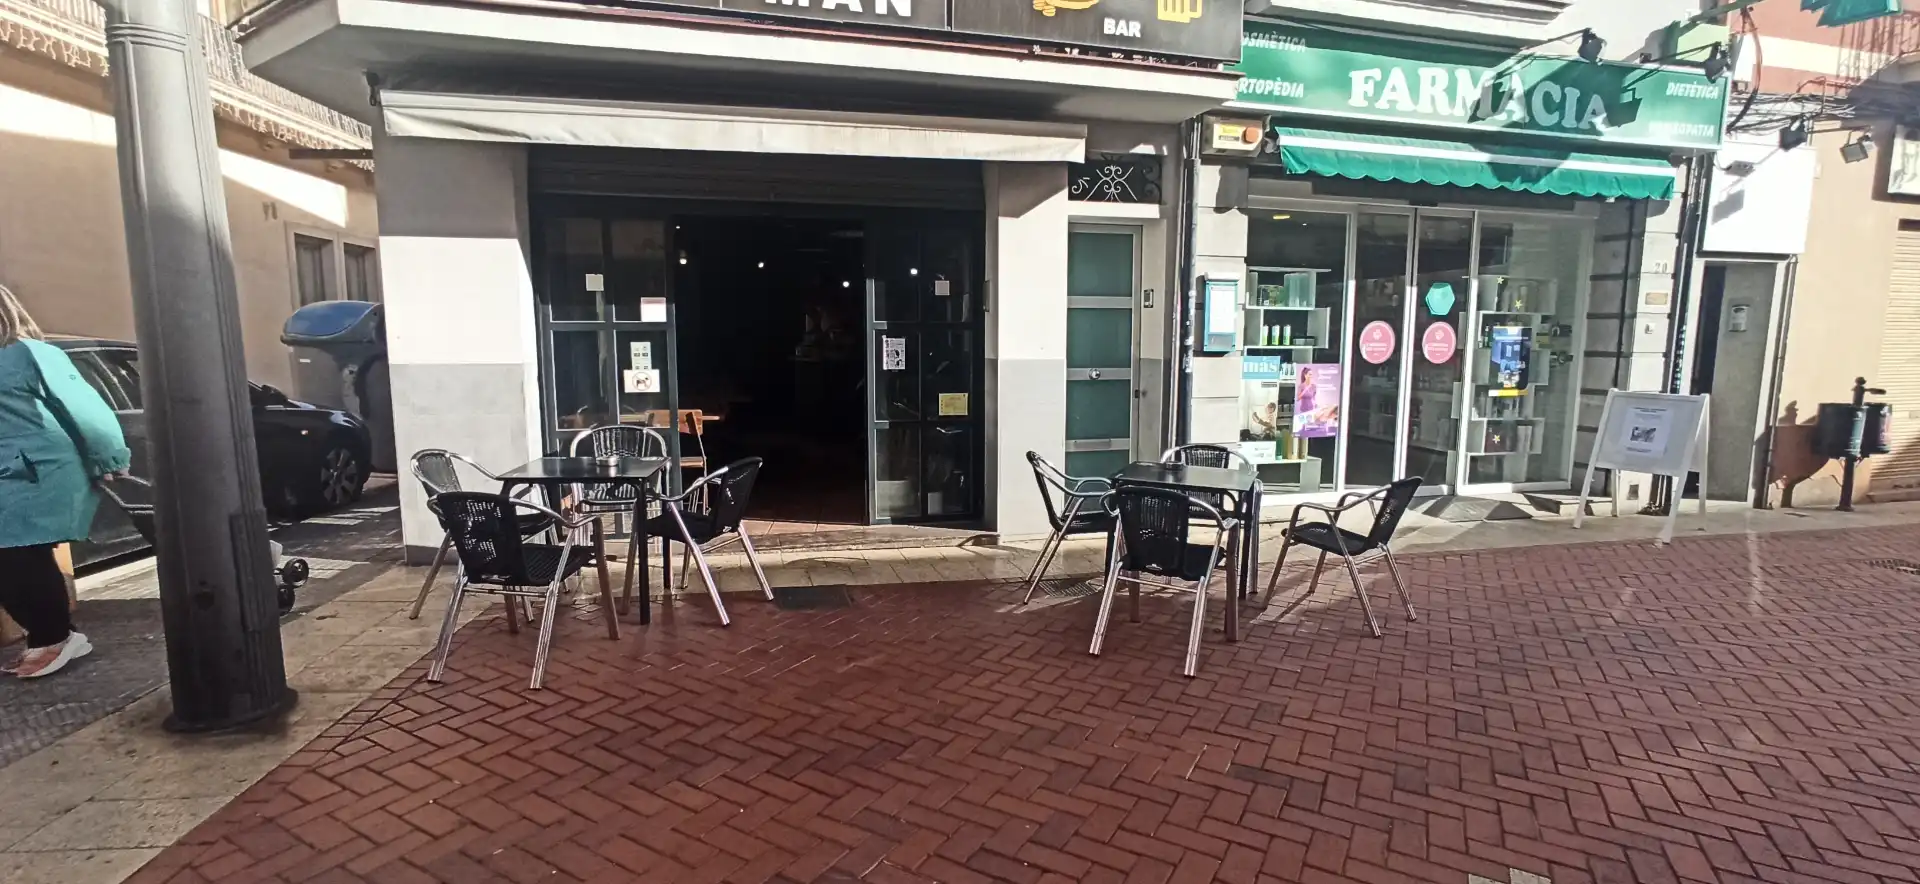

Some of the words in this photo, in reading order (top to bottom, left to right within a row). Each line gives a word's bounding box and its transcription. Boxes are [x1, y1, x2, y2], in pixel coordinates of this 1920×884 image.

[1103, 17, 1141, 38] BAR
[1242, 30, 1306, 52] OSMÈTICA
[1238, 76, 1304, 98] RTOPÈDIA
[1348, 66, 1610, 130] FARMACIA
[1649, 121, 1715, 138] OPATIA
